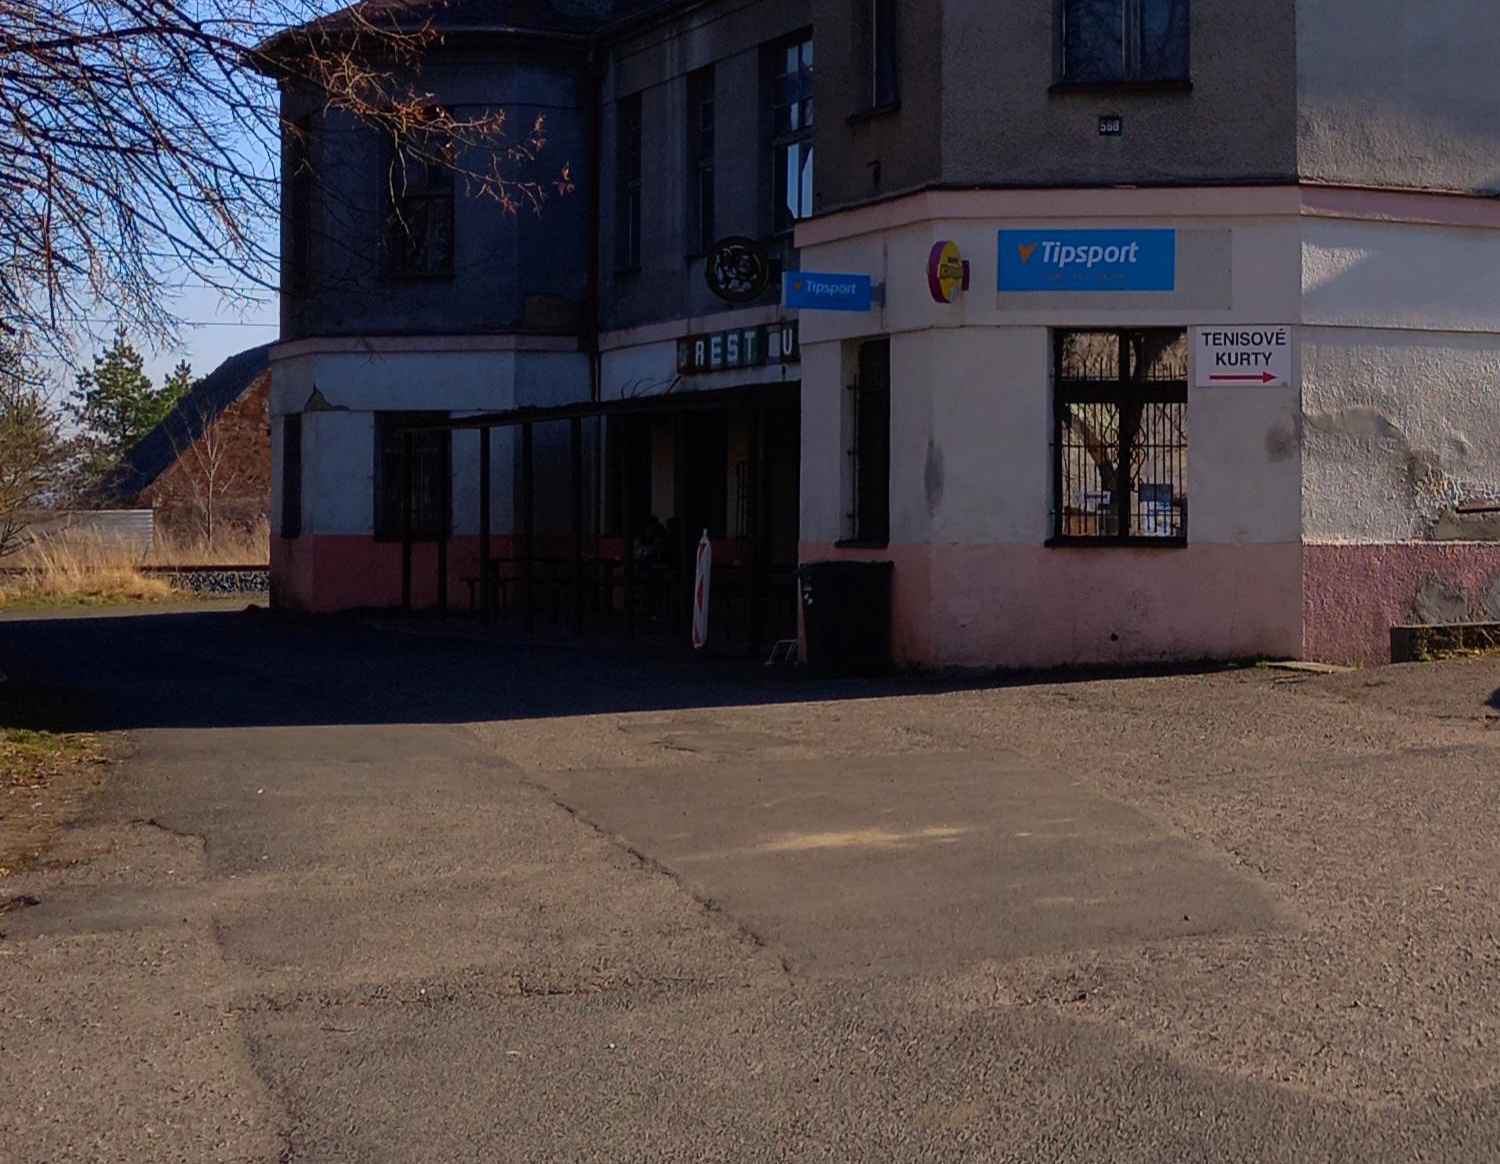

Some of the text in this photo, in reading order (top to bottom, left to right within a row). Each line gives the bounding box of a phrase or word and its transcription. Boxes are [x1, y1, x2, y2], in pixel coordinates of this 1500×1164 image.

[1041, 241, 1139, 268] Tipsport
[805, 279, 857, 296] Tipsport
[1201, 327, 1286, 346] TENISOVÉ
[1215, 352, 1273, 366] KURTY
